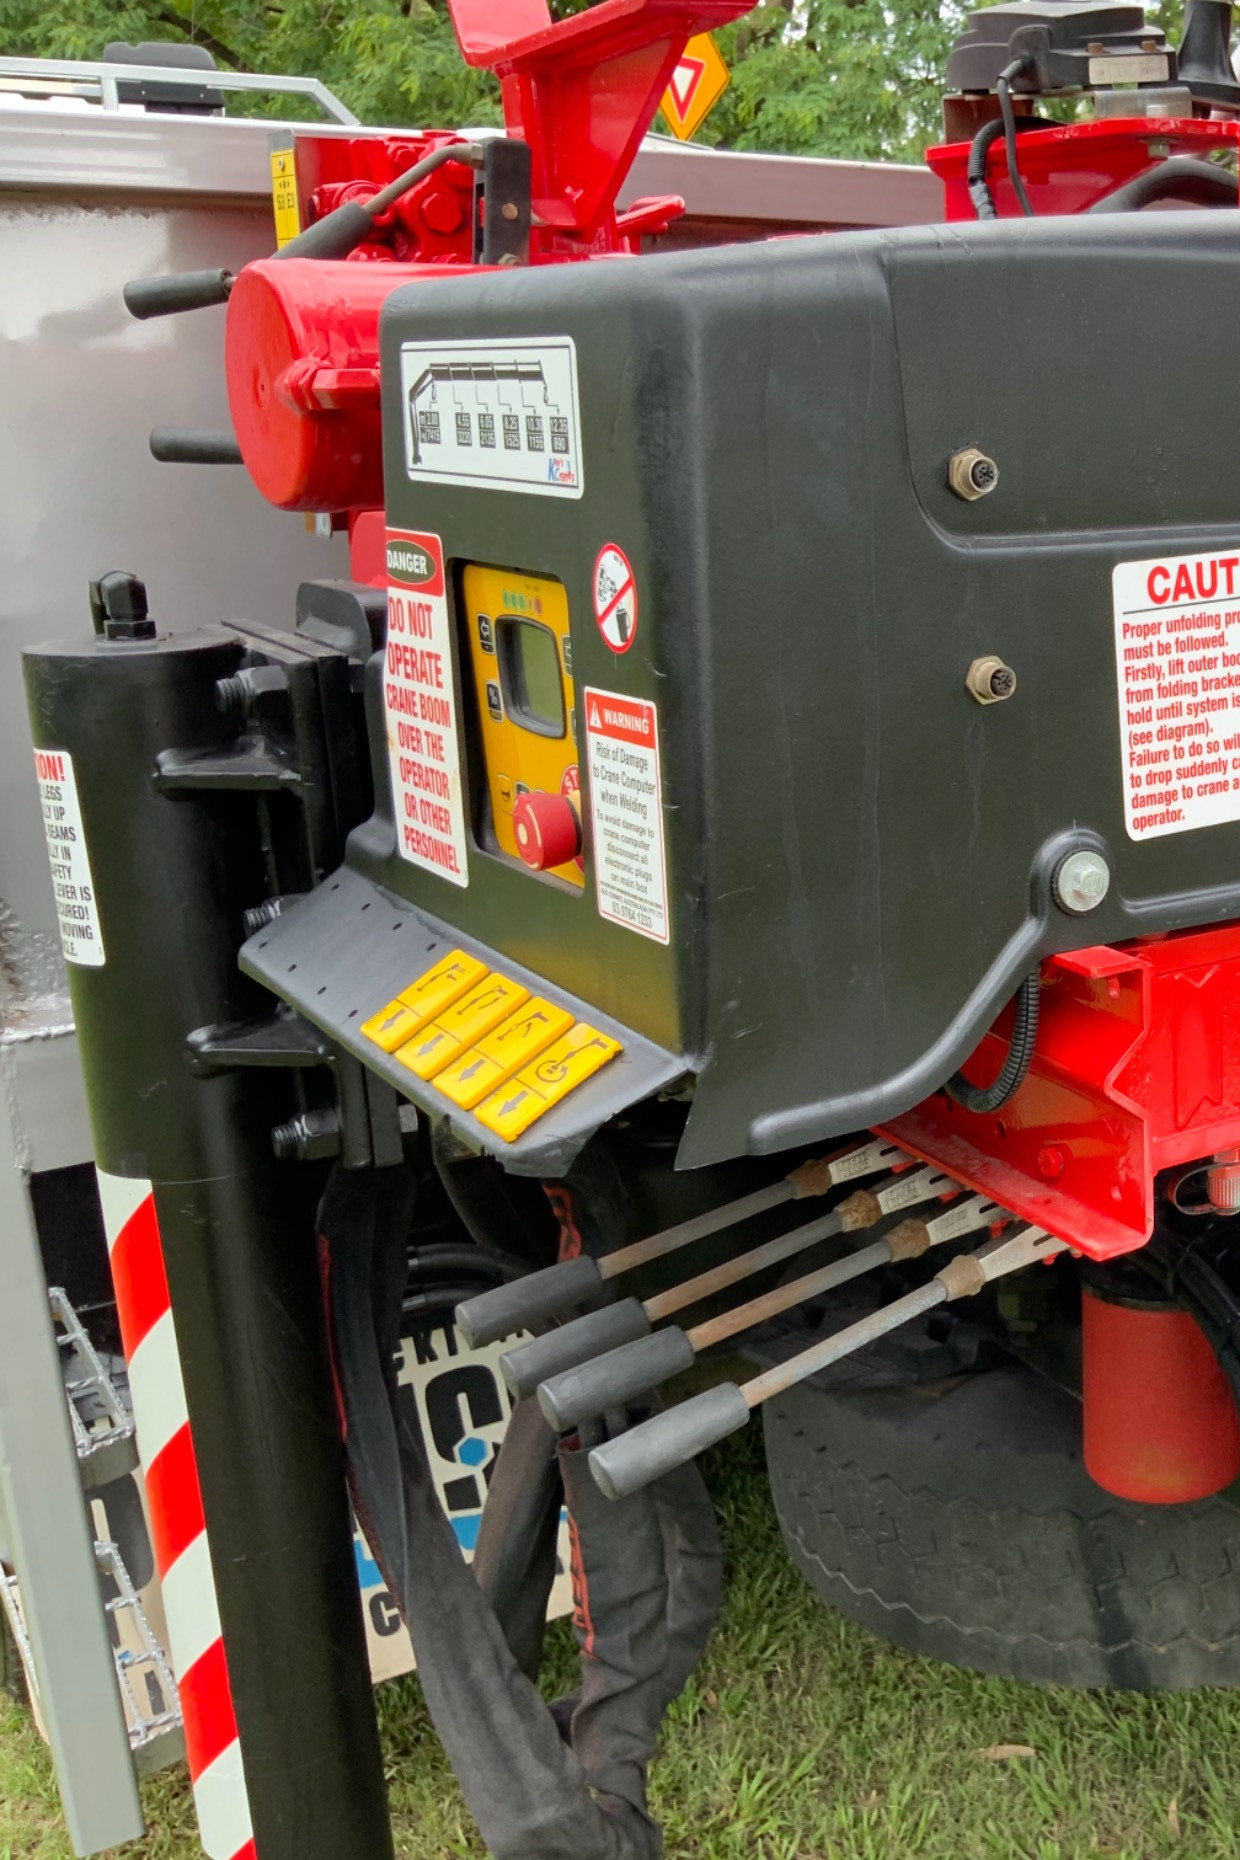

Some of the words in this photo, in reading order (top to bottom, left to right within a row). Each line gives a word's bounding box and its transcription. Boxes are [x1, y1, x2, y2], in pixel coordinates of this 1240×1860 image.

[387, 549, 427, 575] DANGER
[388, 596, 405, 633] DO
[408, 600, 433, 640] NOT
[1122, 621, 1163, 640] Proper
[1166, 613, 1222, 633] unfolding
[1123, 642, 1155, 661] must
[1157, 640, 1173, 656] be
[1174, 631, 1229, 653] followed.
[387, 641, 443, 689] OPERATE
[1124, 663, 1166, 682] Firstly,
[1168, 658, 1186, 676] lift
[1188, 656, 1220, 673] outer
[386, 683, 418, 718] CRANE
[420, 691, 451, 728] BOOM
[1125, 688, 1155, 704] from
[1156, 680, 1199, 699] folding
[603, 708, 650, 735] WARNING
[1126, 707, 1154, 725] hold
[1156, 702, 1184, 721] until
[1186, 697, 1229, 718] system
[397, 720, 423, 755] OVER
[424, 730, 445, 763] THE
[1128, 731, 1154, 751] (see
[1156, 719, 1214, 742] diagram).
[596, 741, 611, 760] Risk
[612, 747, 620, 762] of
[620, 748, 649, 773] Damage
[1129, 749, 1171, 767] Failure
[1173, 745, 1186, 760] to
[1188, 742, 1204, 757] do
[1206, 740, 1221, 754] so
[399, 755, 450, 800] OPERATOR
[593, 764, 600, 778] to
[600, 765, 621, 785] Crane
[621, 771, 657, 796] Computer
[1129, 773, 1143, 789] to
[1145, 769, 1174, 786] drop
[1176, 758, 1229, 780] suddenly
[600, 789, 619, 806] when
[619, 793, 648, 820] Welding
[1131, 789, 1180, 810] damage
[1181, 785, 1195, 800] to
[1196, 780, 1230, 797] crane
[404, 791, 419, 822] OR
[420, 798, 452, 836] OTHER
[1132, 808, 1185, 832] operator.
[404, 824, 460, 874] PERSONNEL
[80, 886, 91, 901] IS
